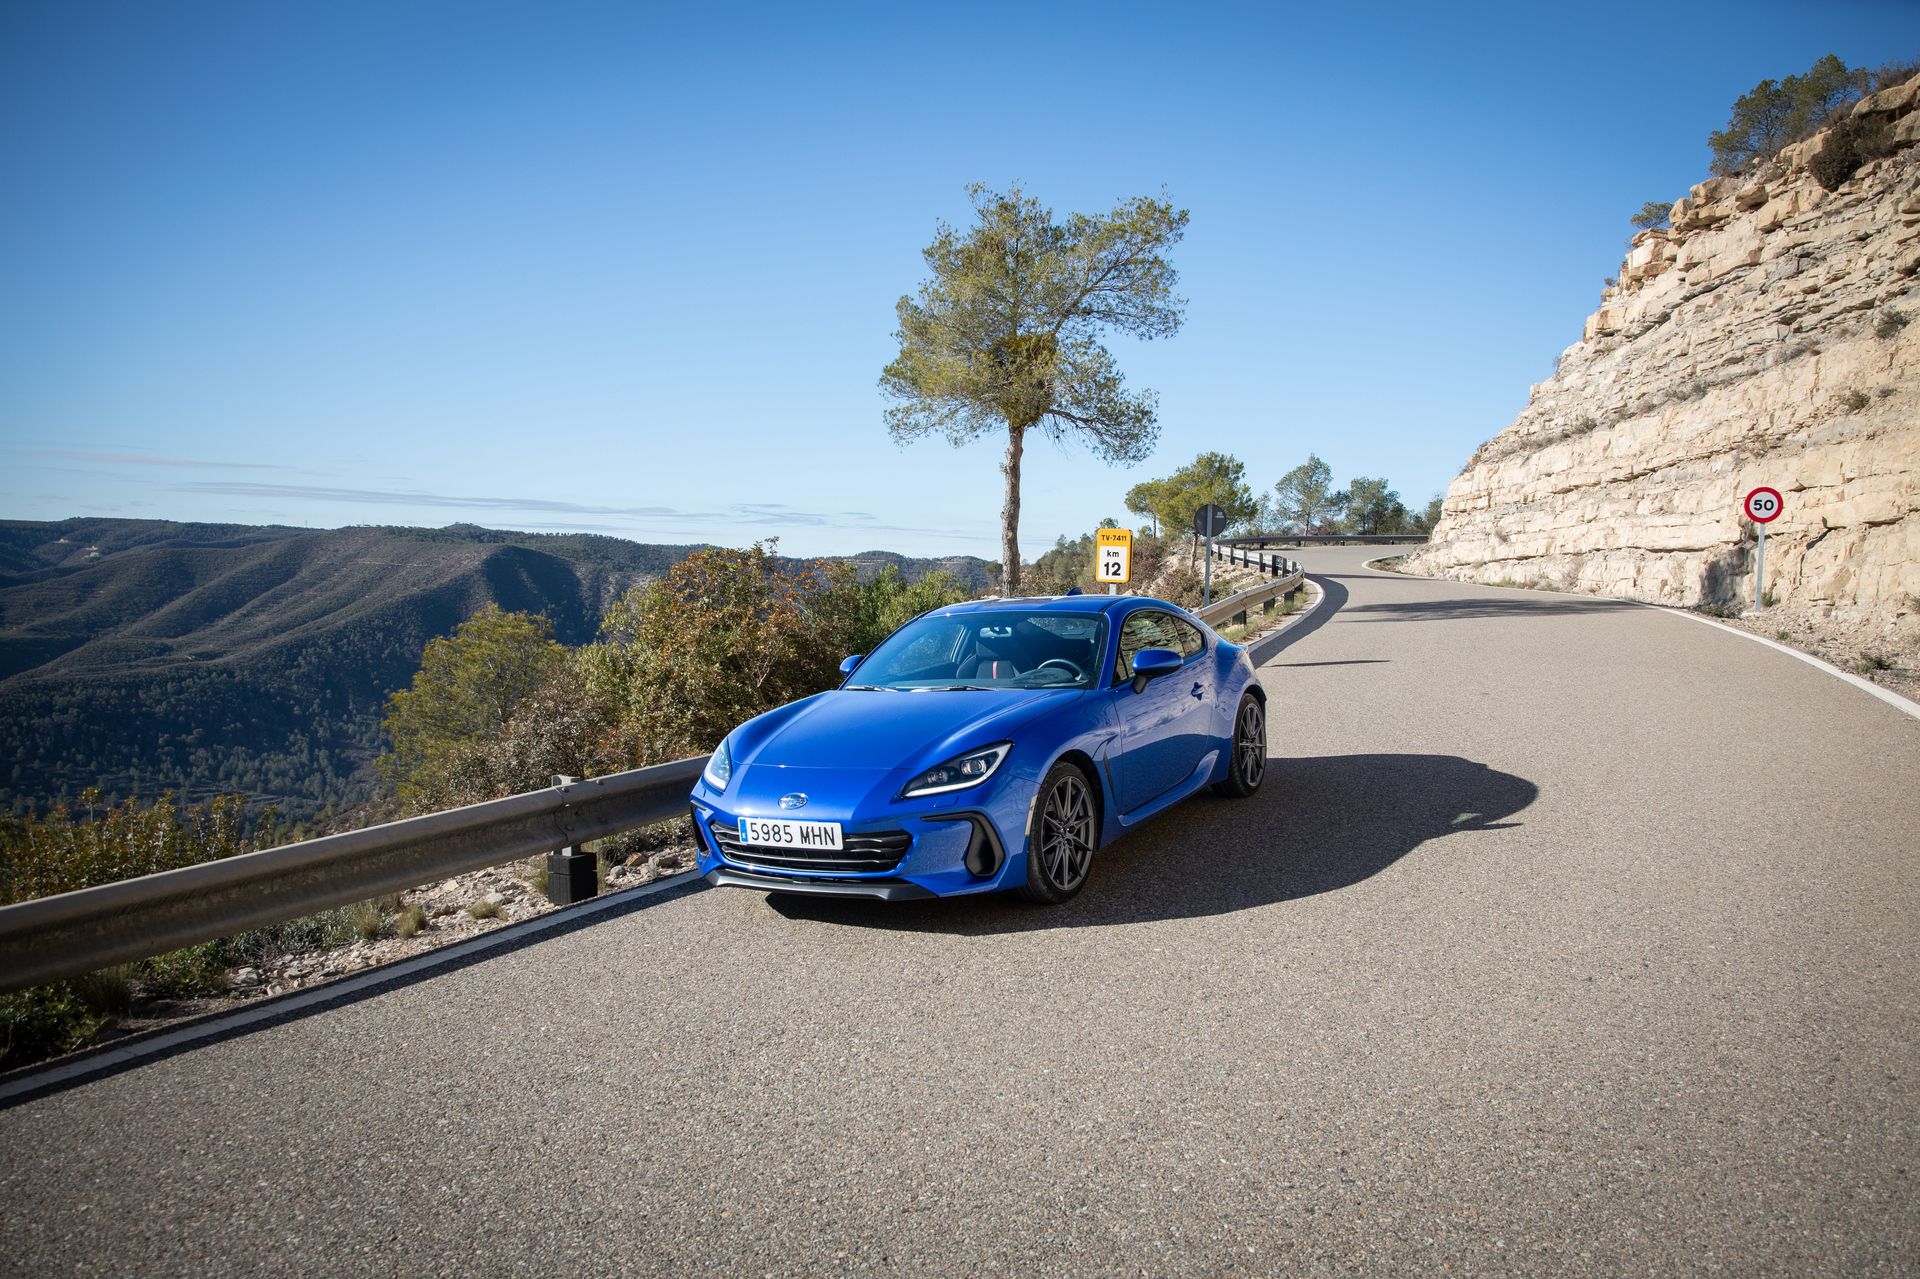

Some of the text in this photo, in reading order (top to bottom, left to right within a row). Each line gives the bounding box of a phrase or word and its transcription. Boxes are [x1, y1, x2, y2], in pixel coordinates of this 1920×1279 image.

[1753, 499, 1774, 511] 50
[1106, 549, 1120, 557] km
[1104, 561, 1121, 576] 12
[750, 822, 836, 847] 5985 MHN
